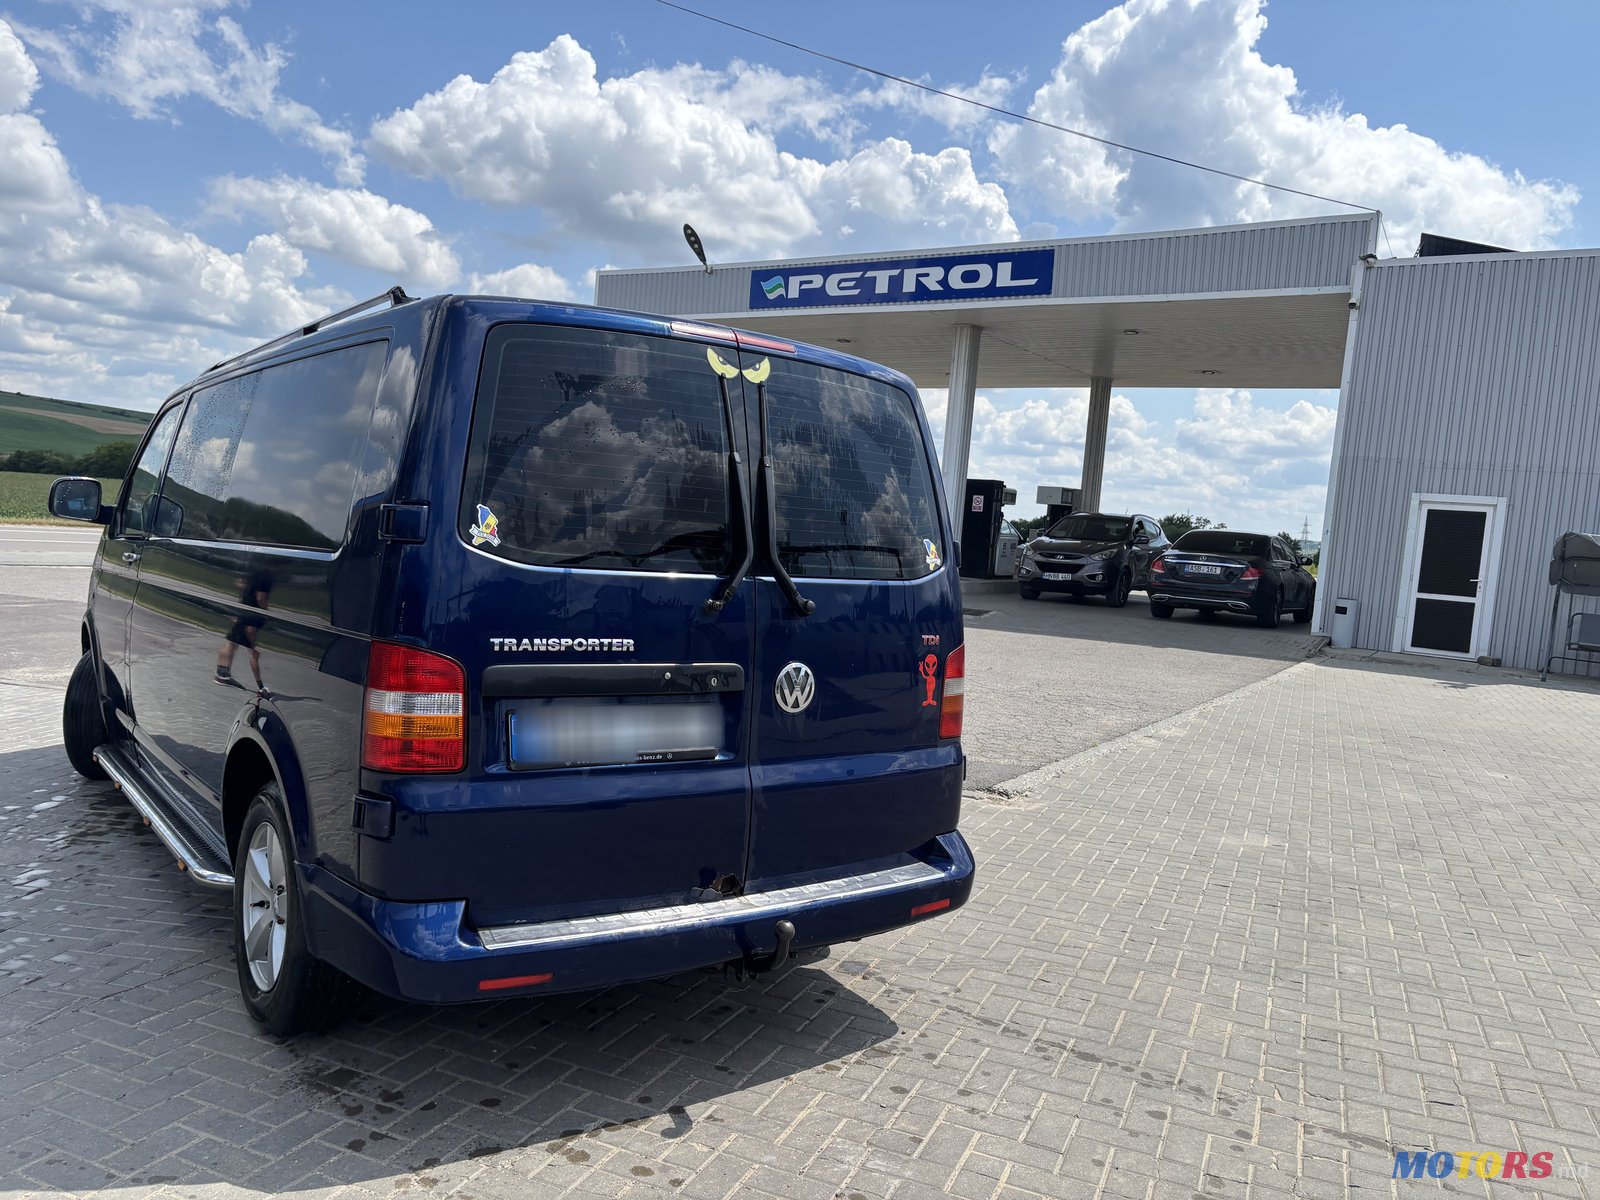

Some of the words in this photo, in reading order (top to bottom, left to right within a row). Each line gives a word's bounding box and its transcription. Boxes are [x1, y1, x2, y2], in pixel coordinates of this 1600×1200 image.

[788, 262, 1039, 299] PETROL
[489, 638, 635, 652] TRANSPORTER
[776, 663, 814, 712] VW
